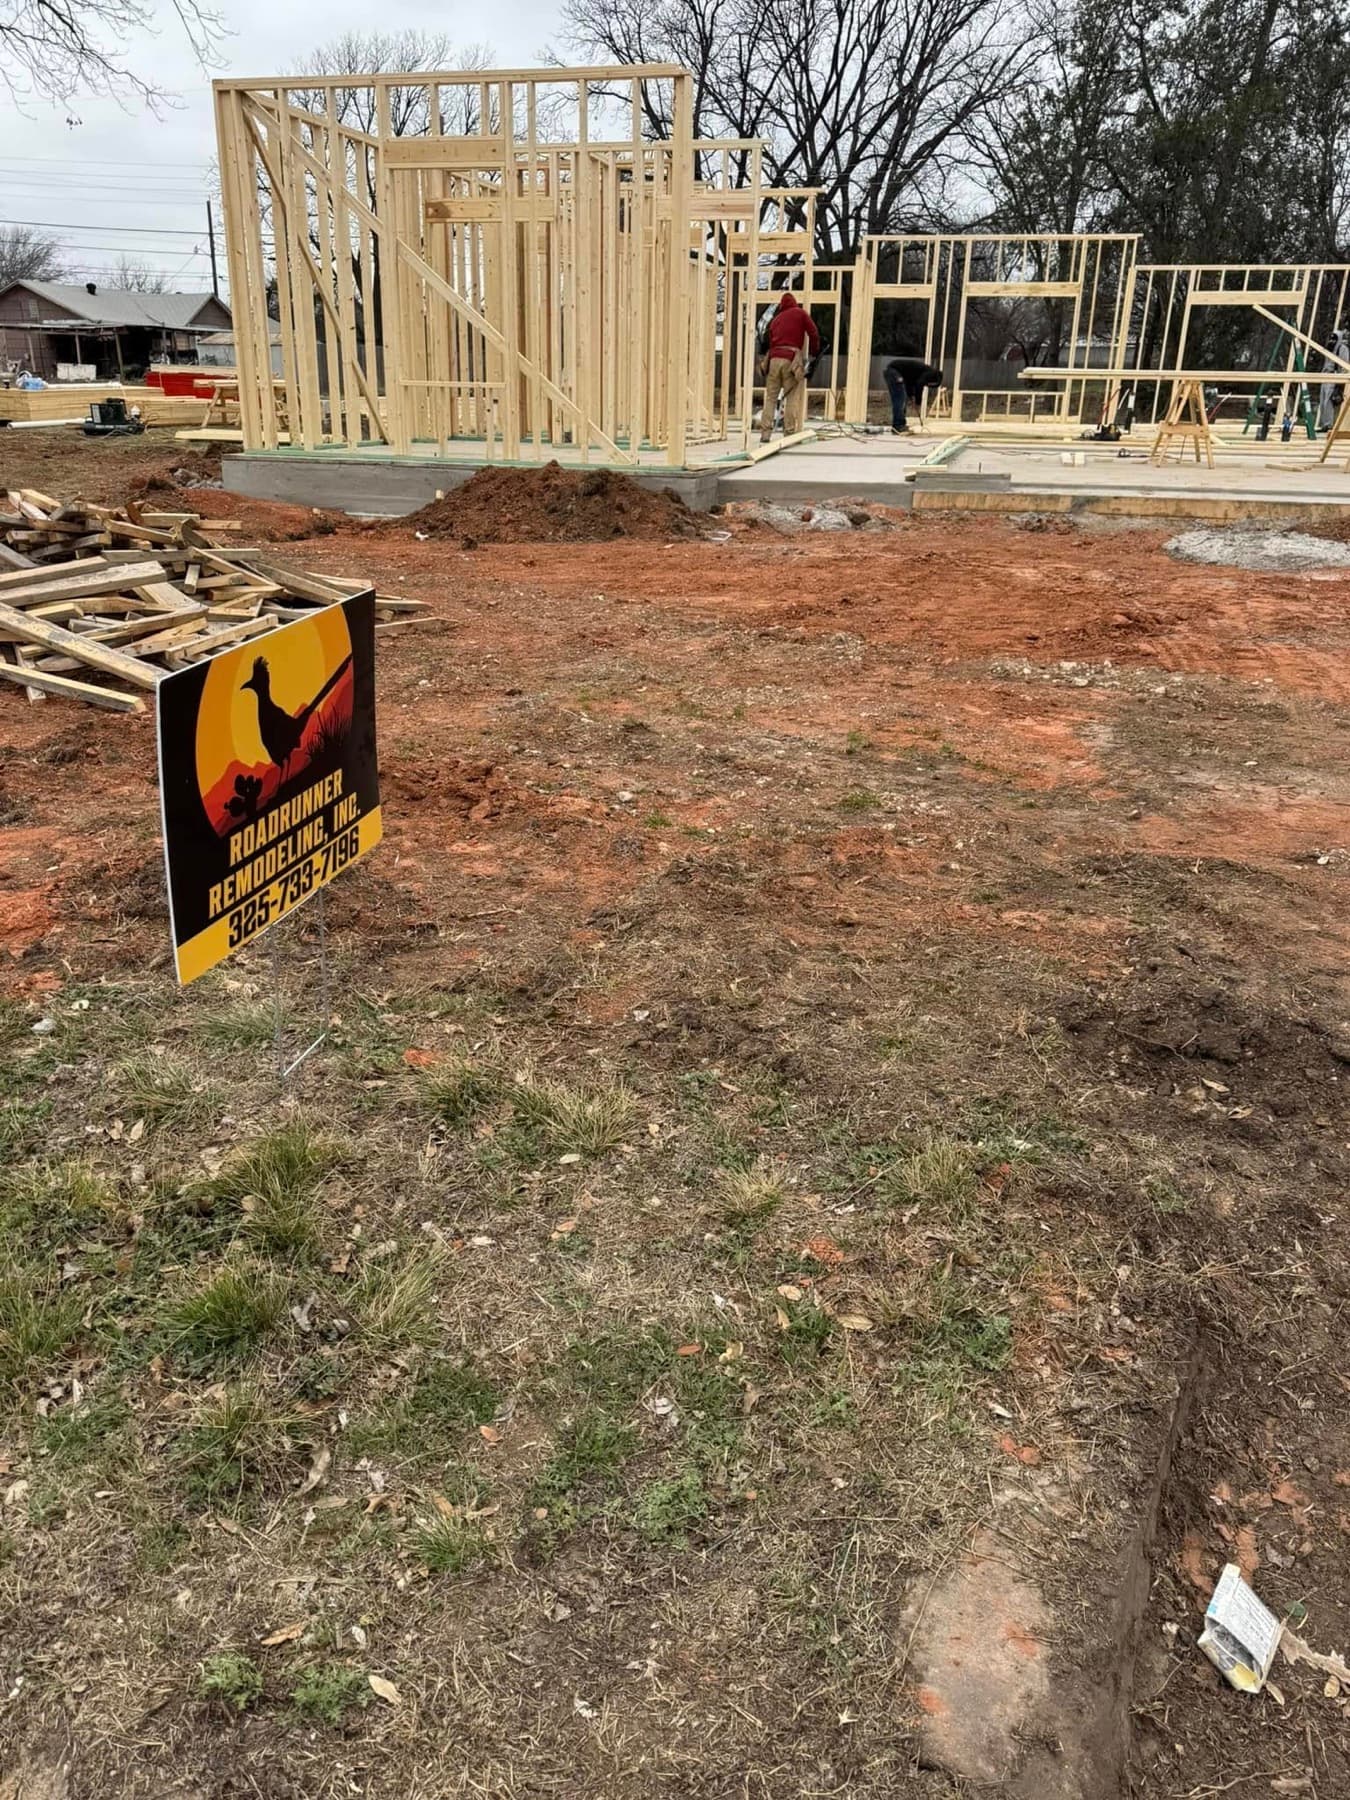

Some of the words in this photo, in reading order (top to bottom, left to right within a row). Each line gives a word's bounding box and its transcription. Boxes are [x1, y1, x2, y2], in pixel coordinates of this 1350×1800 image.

[208, 816, 328, 919] REMODELING,
[333, 792, 361, 832] INC.
[229, 768, 343, 867] ROADRUNNER
[228, 827, 360, 948] 325-733-7196
